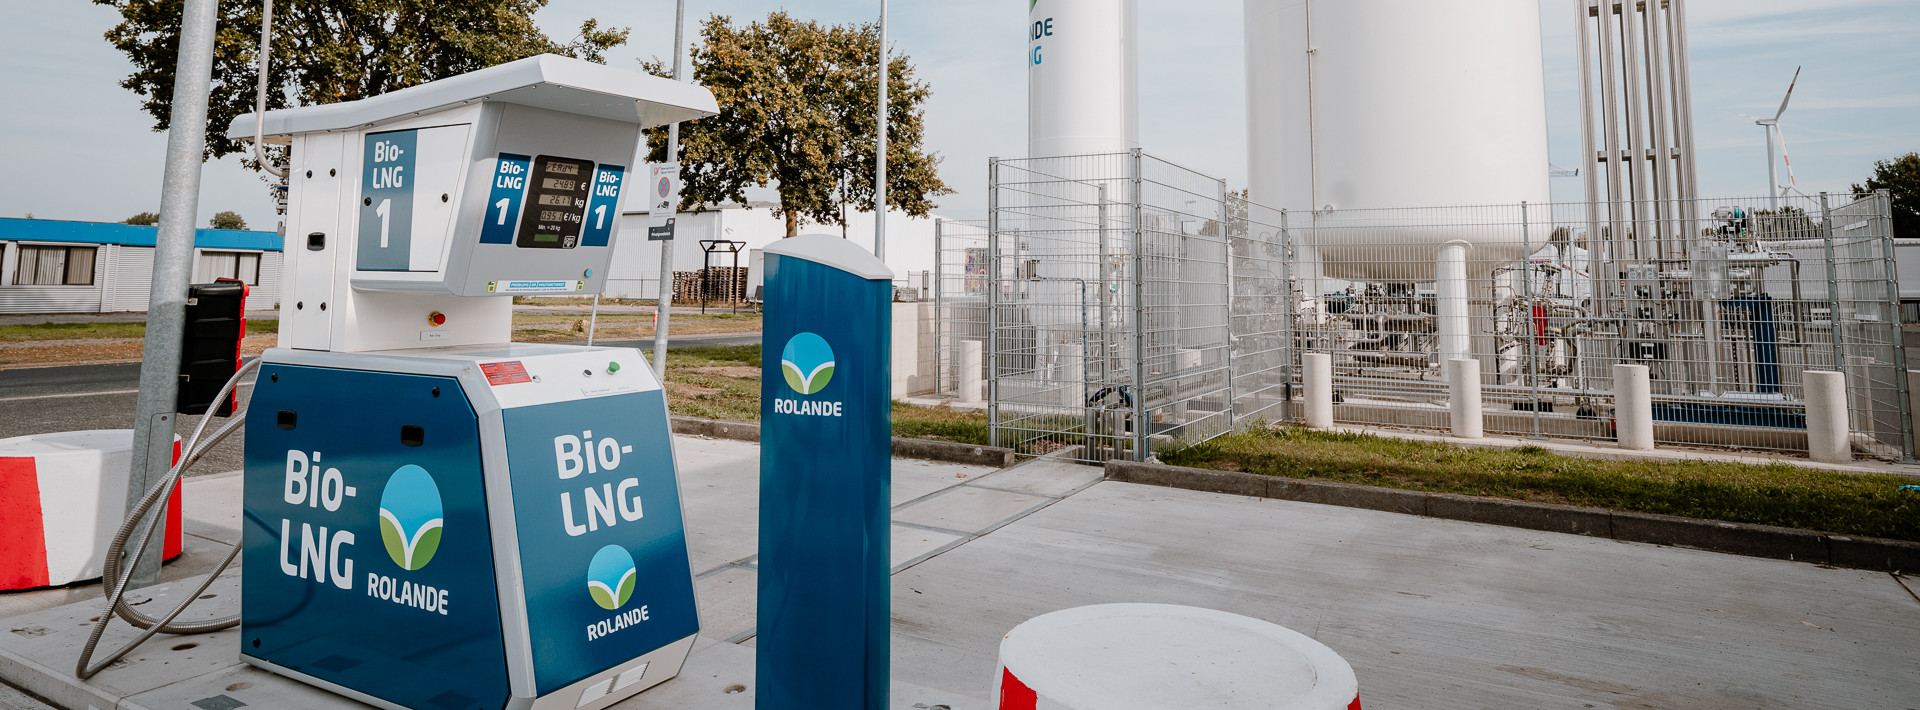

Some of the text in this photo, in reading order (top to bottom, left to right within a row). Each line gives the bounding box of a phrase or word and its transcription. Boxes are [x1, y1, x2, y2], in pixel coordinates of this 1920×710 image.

[374, 140, 404, 163] Bio-
[372, 166, 404, 189] LNG
[500, 161, 525, 174] Bio-
[599, 171, 619, 184] Bio-
[497, 176, 523, 189] LNG
[581, 182, 587, 191] €
[596, 185, 618, 197] LNG
[496, 198, 510, 225] 1
[574, 198, 585, 208] kg
[376, 199, 391, 248] 1
[595, 204, 607, 229] 1
[774, 398, 842, 417] ROLANDE
[554, 429, 633, 480] Bio-
[284, 449, 357, 512] Bio-
[560, 477, 644, 537] LNG
[280, 518, 355, 590] LNG
[367, 572, 449, 616] ROLANDE
[587, 604, 650, 642] ROLANDE
